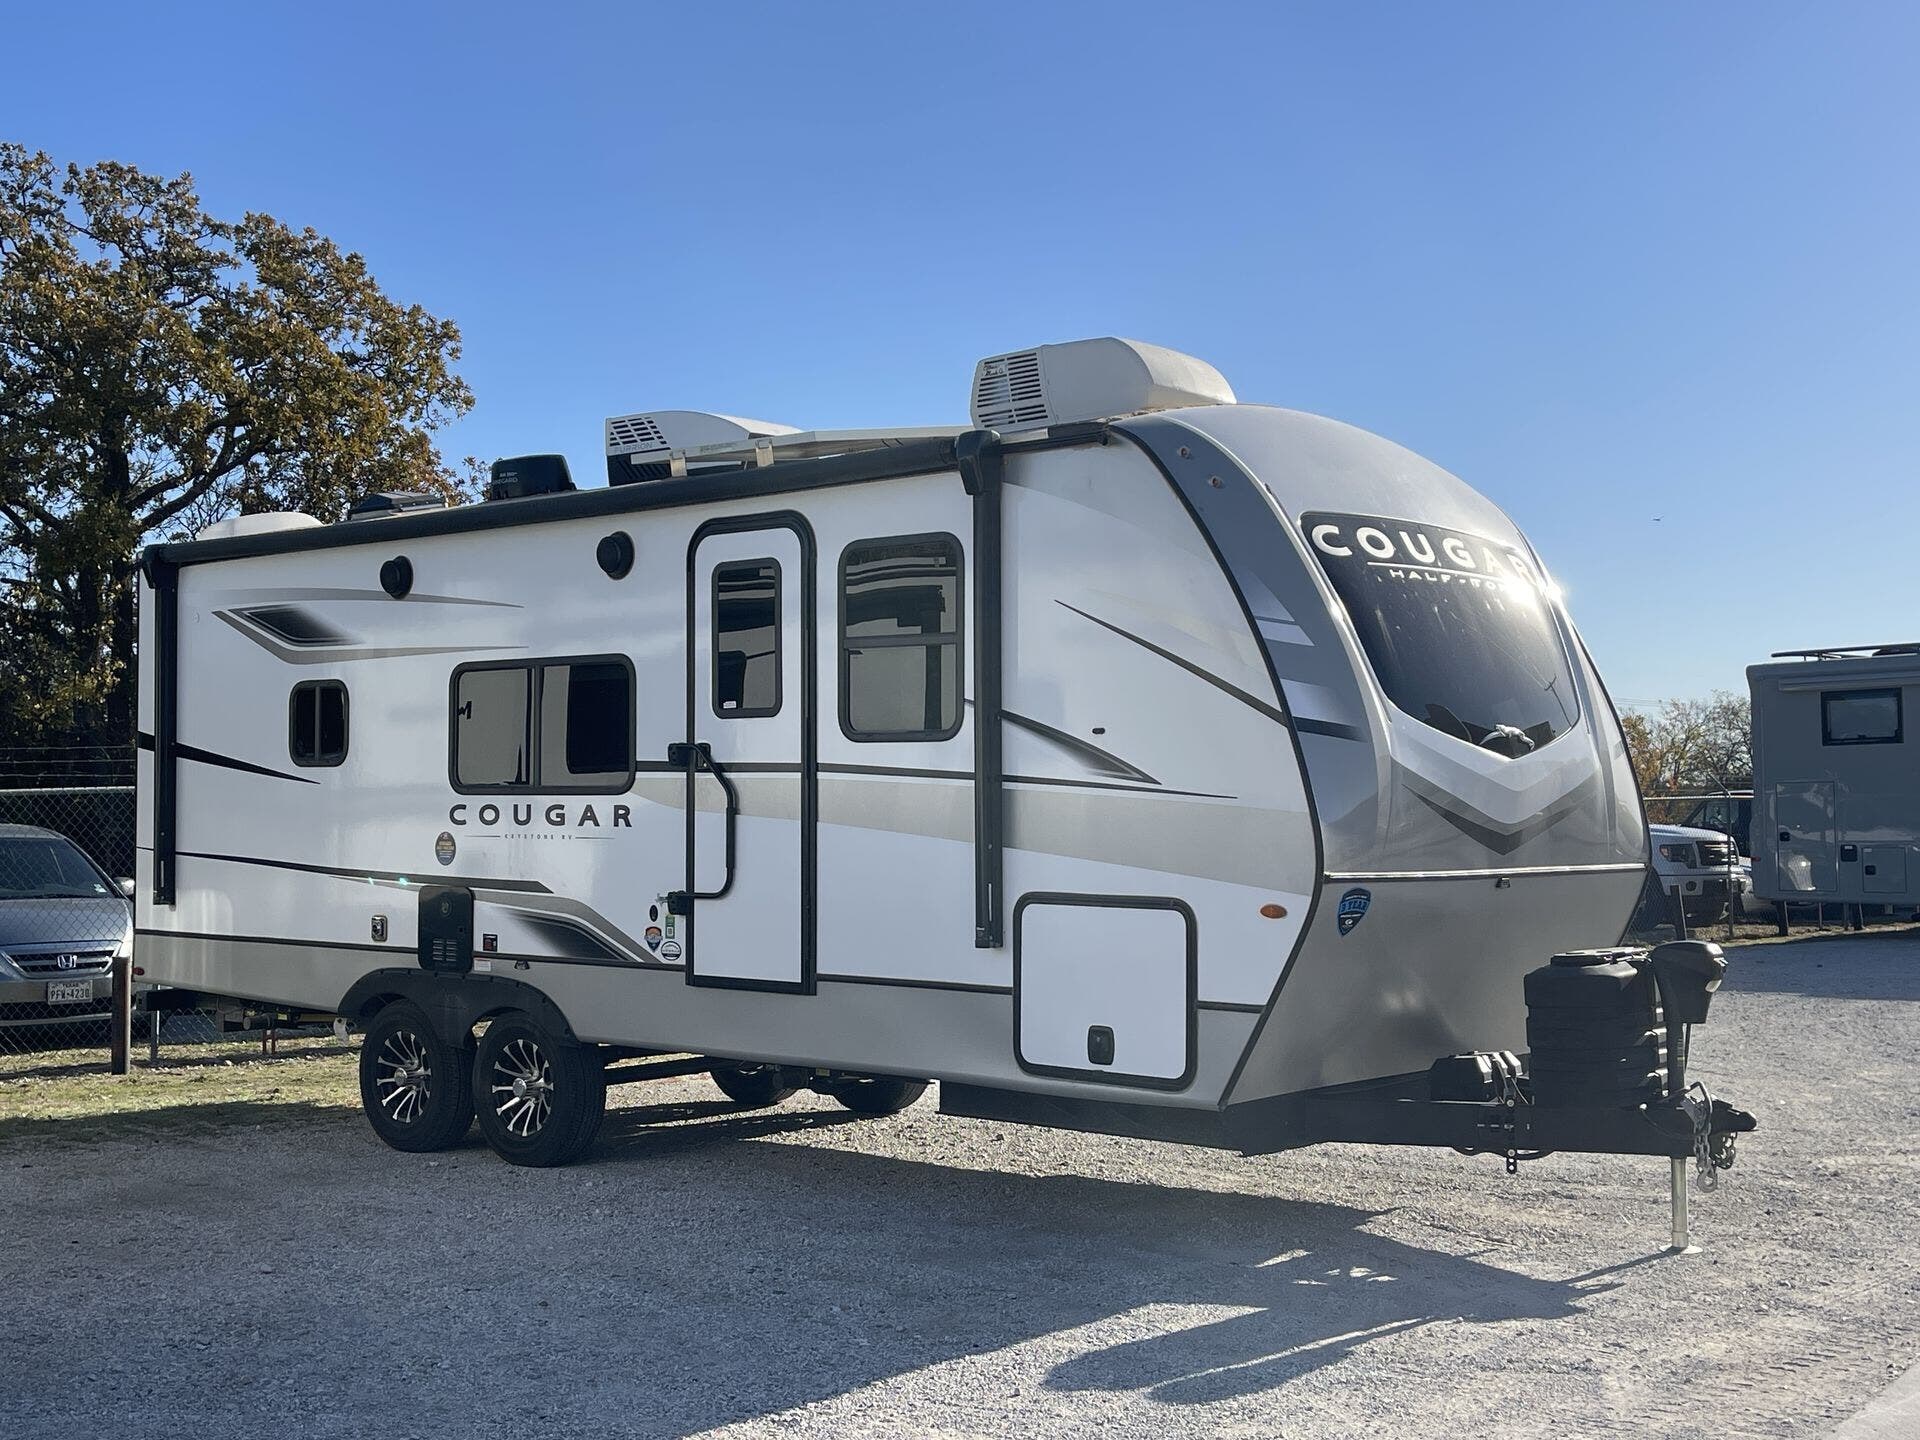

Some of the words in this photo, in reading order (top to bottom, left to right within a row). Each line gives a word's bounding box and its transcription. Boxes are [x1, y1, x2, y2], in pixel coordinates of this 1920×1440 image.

[1312, 524, 1537, 585] COUGAR
[1389, 569, 1505, 592] HALF-TO
[449, 803, 632, 828] COUGAR
